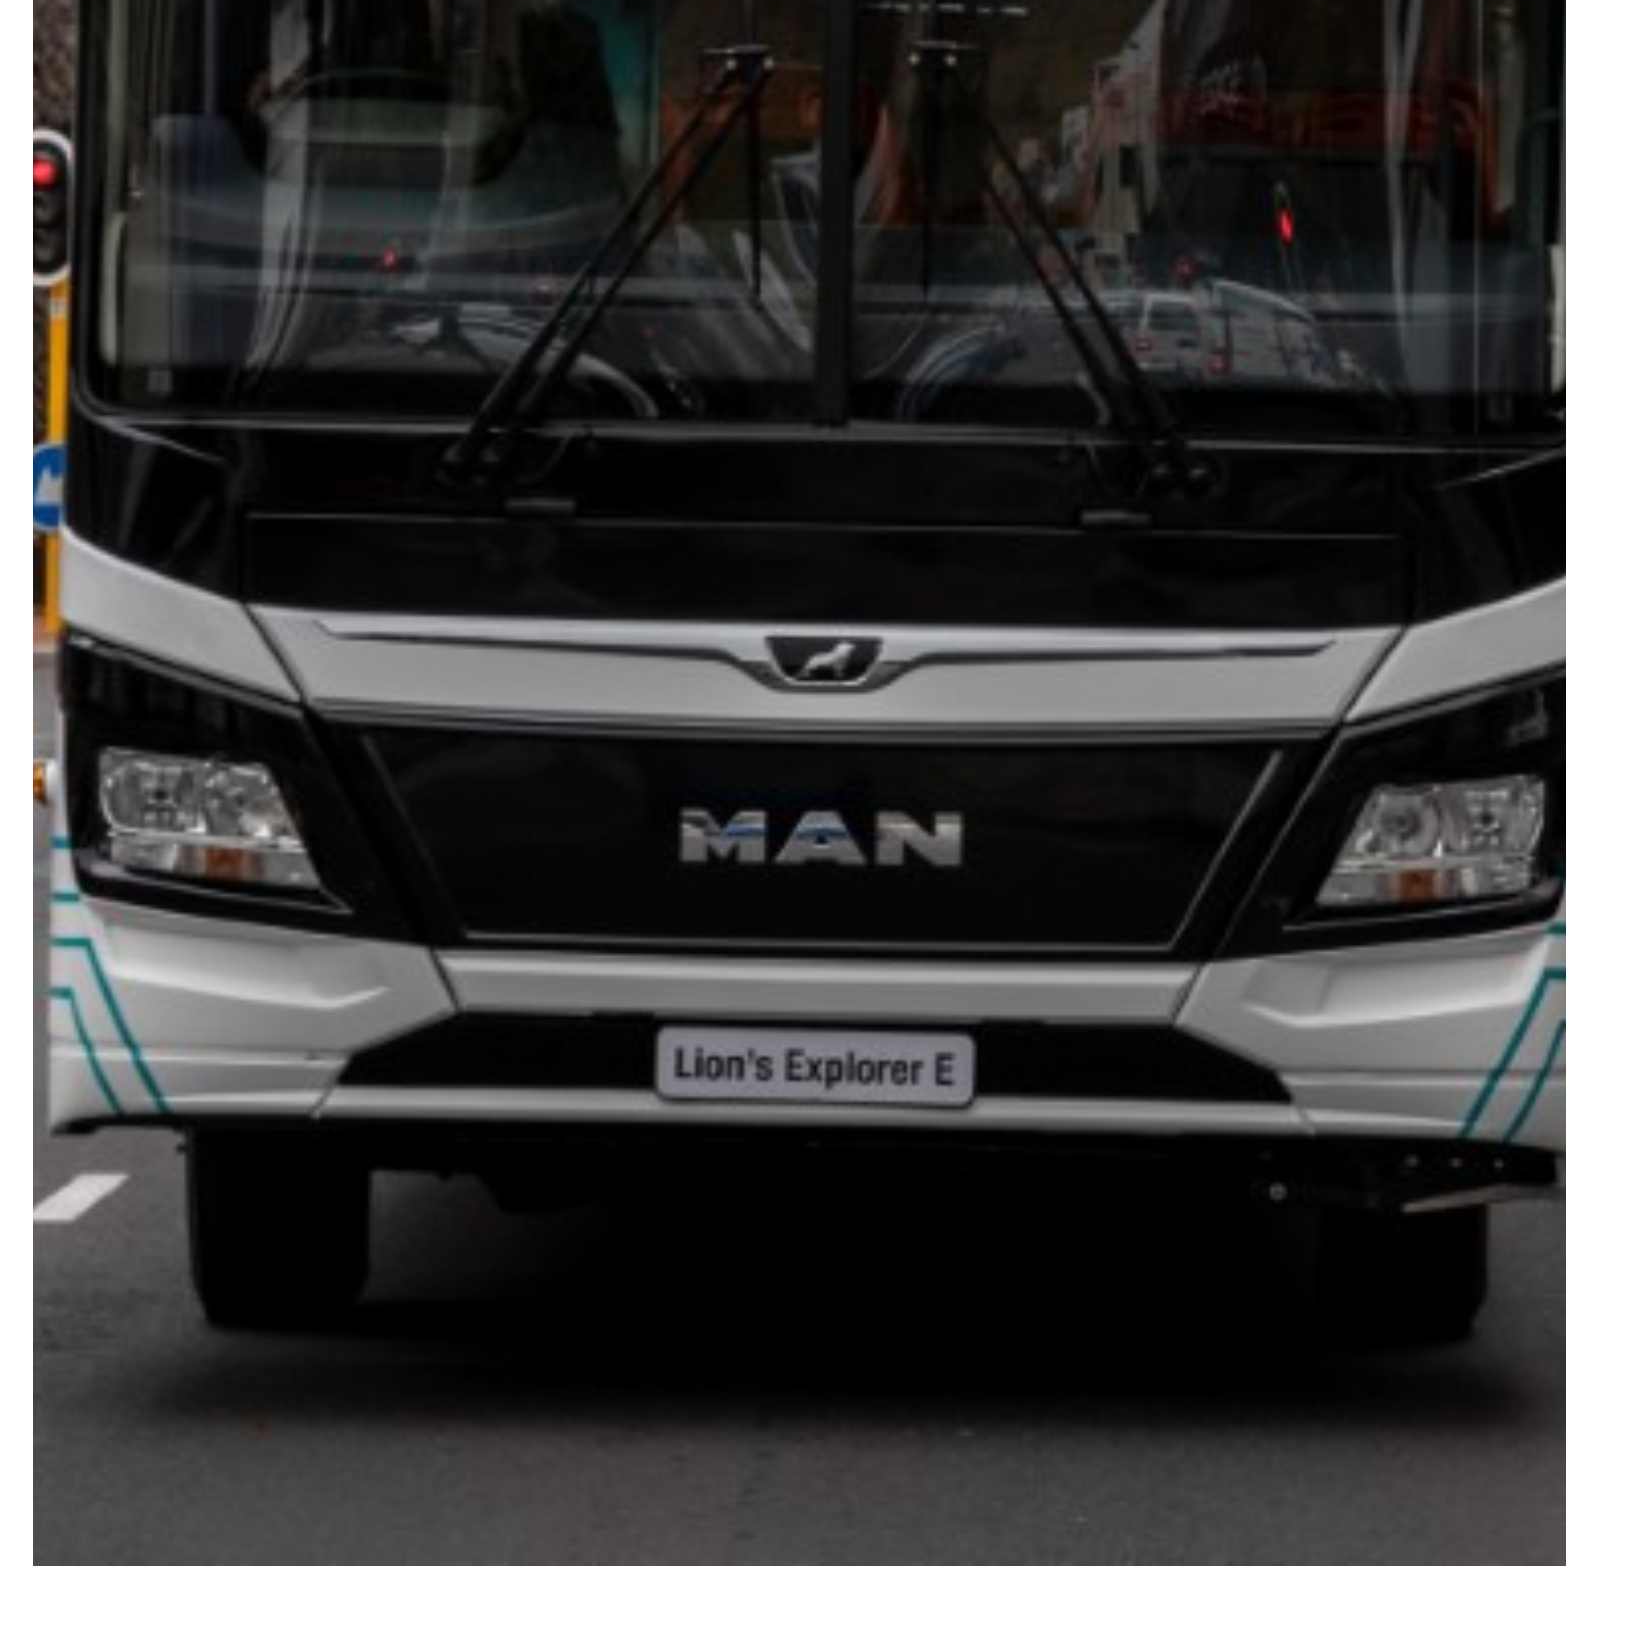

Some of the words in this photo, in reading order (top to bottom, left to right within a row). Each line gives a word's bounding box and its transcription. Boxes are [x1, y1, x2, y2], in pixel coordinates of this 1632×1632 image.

[679, 808, 963, 867] MAN
[674, 1046, 773, 1082] Lion's
[784, 1047, 924, 1090] Explorer
[935, 1051, 956, 1087] E
